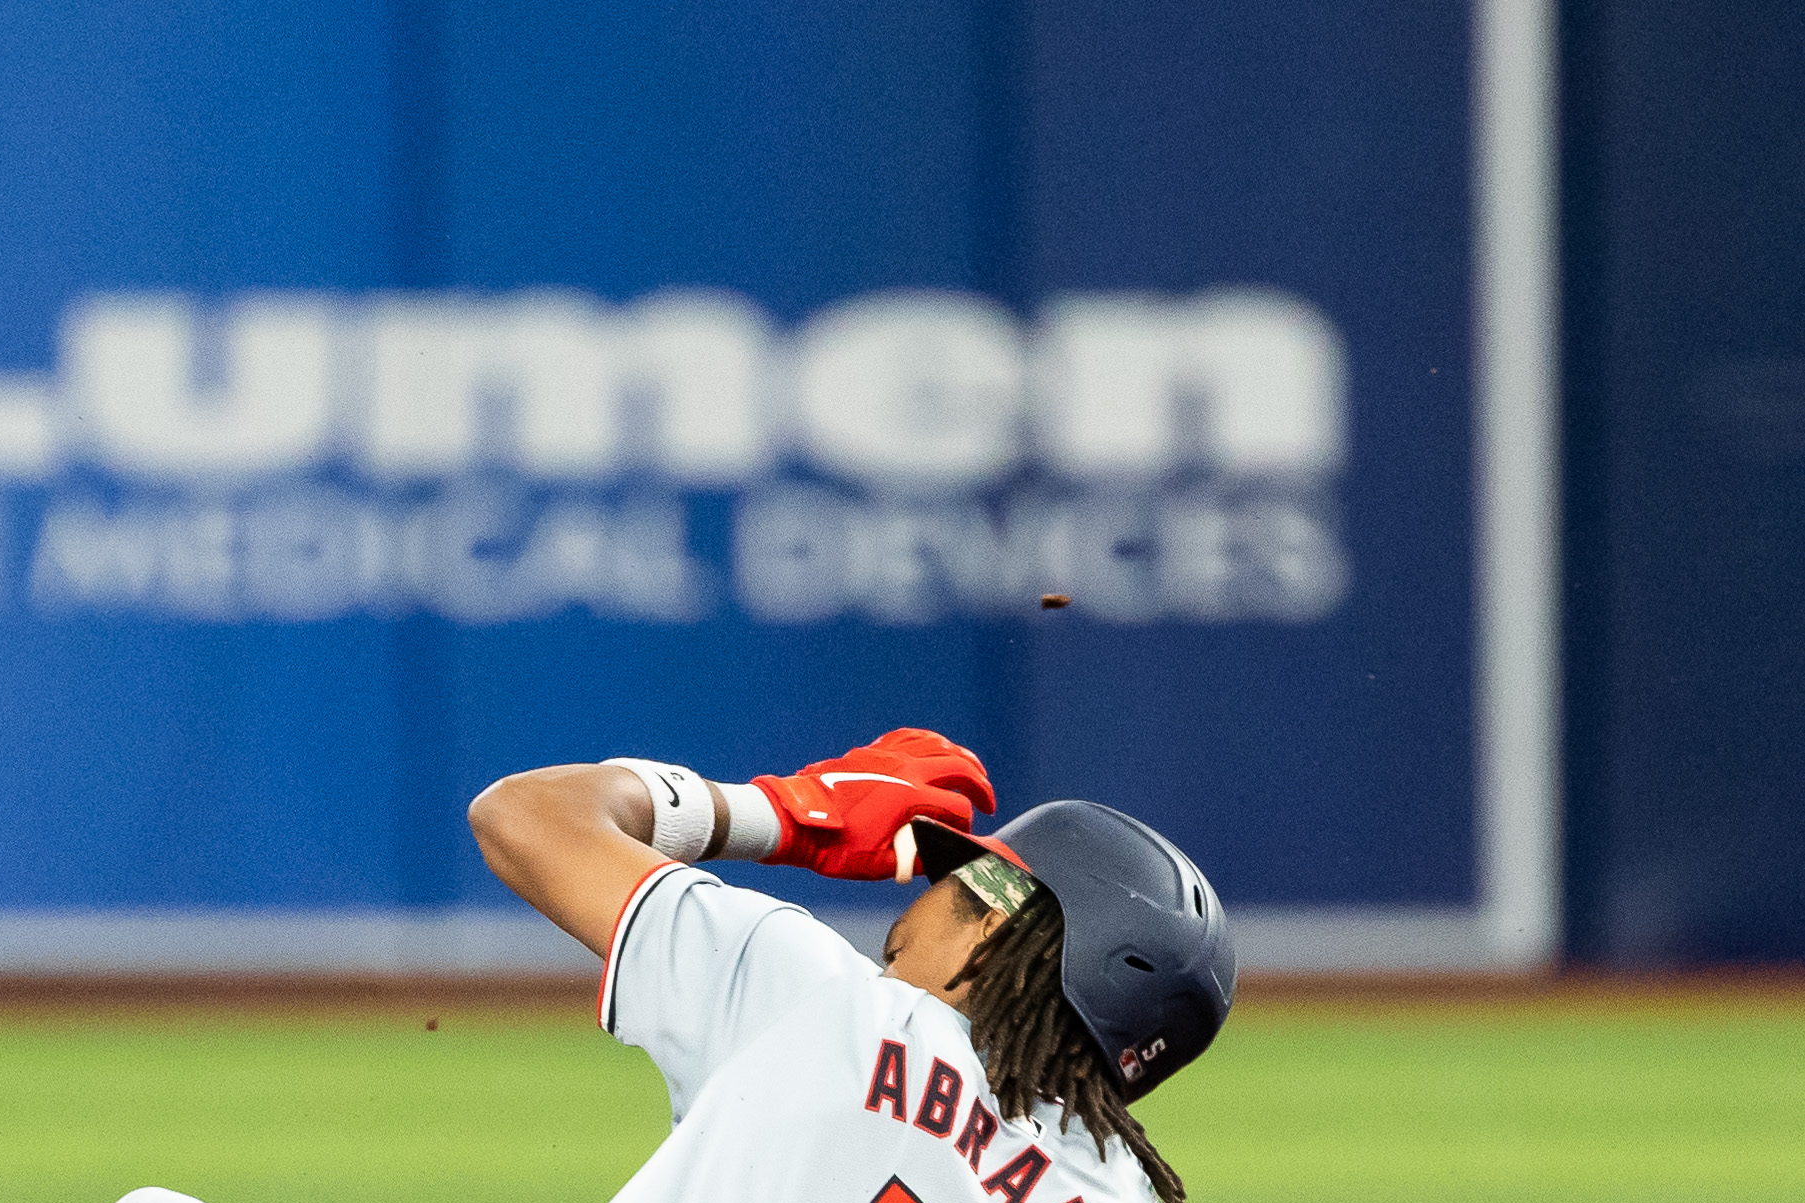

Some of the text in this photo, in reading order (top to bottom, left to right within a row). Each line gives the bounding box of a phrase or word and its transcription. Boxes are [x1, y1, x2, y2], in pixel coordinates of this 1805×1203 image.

[34, 500, 706, 620] MEDICAL
[734, 500, 1344, 620] DEVICES
[1141, 1037, 1166, 1060] 5
